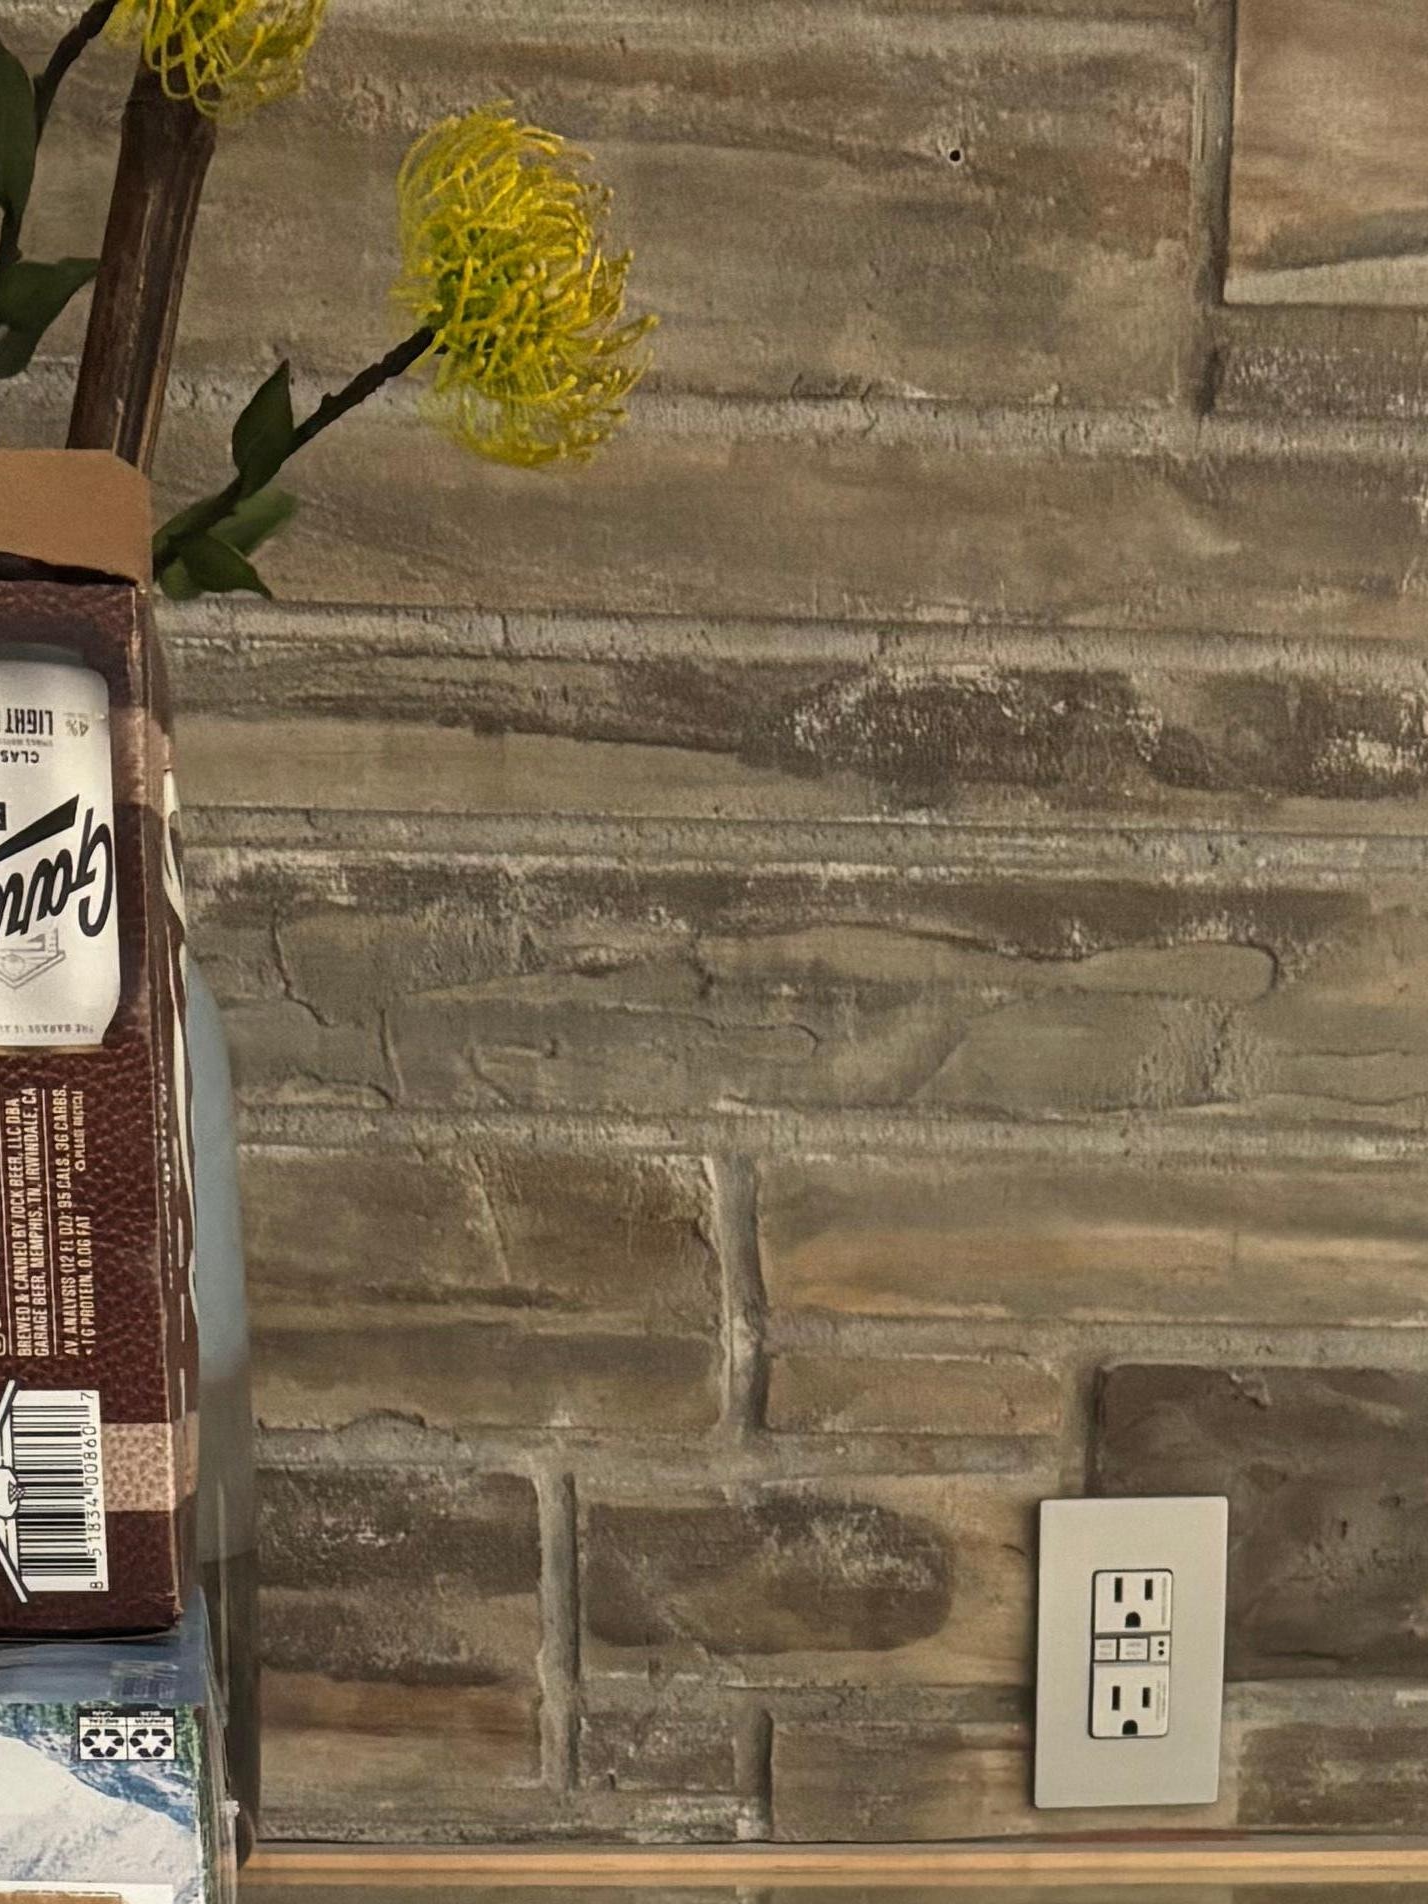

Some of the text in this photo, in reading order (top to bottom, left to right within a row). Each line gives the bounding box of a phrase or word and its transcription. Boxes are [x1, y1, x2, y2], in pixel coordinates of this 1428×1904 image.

[5, 708, 53, 735] LIGHT
[5, 1098, 20, 1124] DBA
[6, 1126, 21, 1148] LLC
[8, 1153, 24, 1186] BEER,
[57, 1192, 72, 1208] 95
[11, 1222, 27, 1237] BY
[21, 1088, 49, 1356] GARAGE BEER, MEMPHIS, TN, IRWINDALE, CA
[75, 1216, 92, 1235] FAT
[59, 1240, 74, 1252] FL
[12, 1241, 29, 1290] CANNED
[59, 1256, 76, 1273] (12
[15, 1294, 29, 1302] &
[61, 1277, 77, 1334] ANALYSIS
[16, 1306, 32, 1356] BREWED
[82, 1424, 98, 1486] 00860
[85, 1492, 101, 1557] 51834
